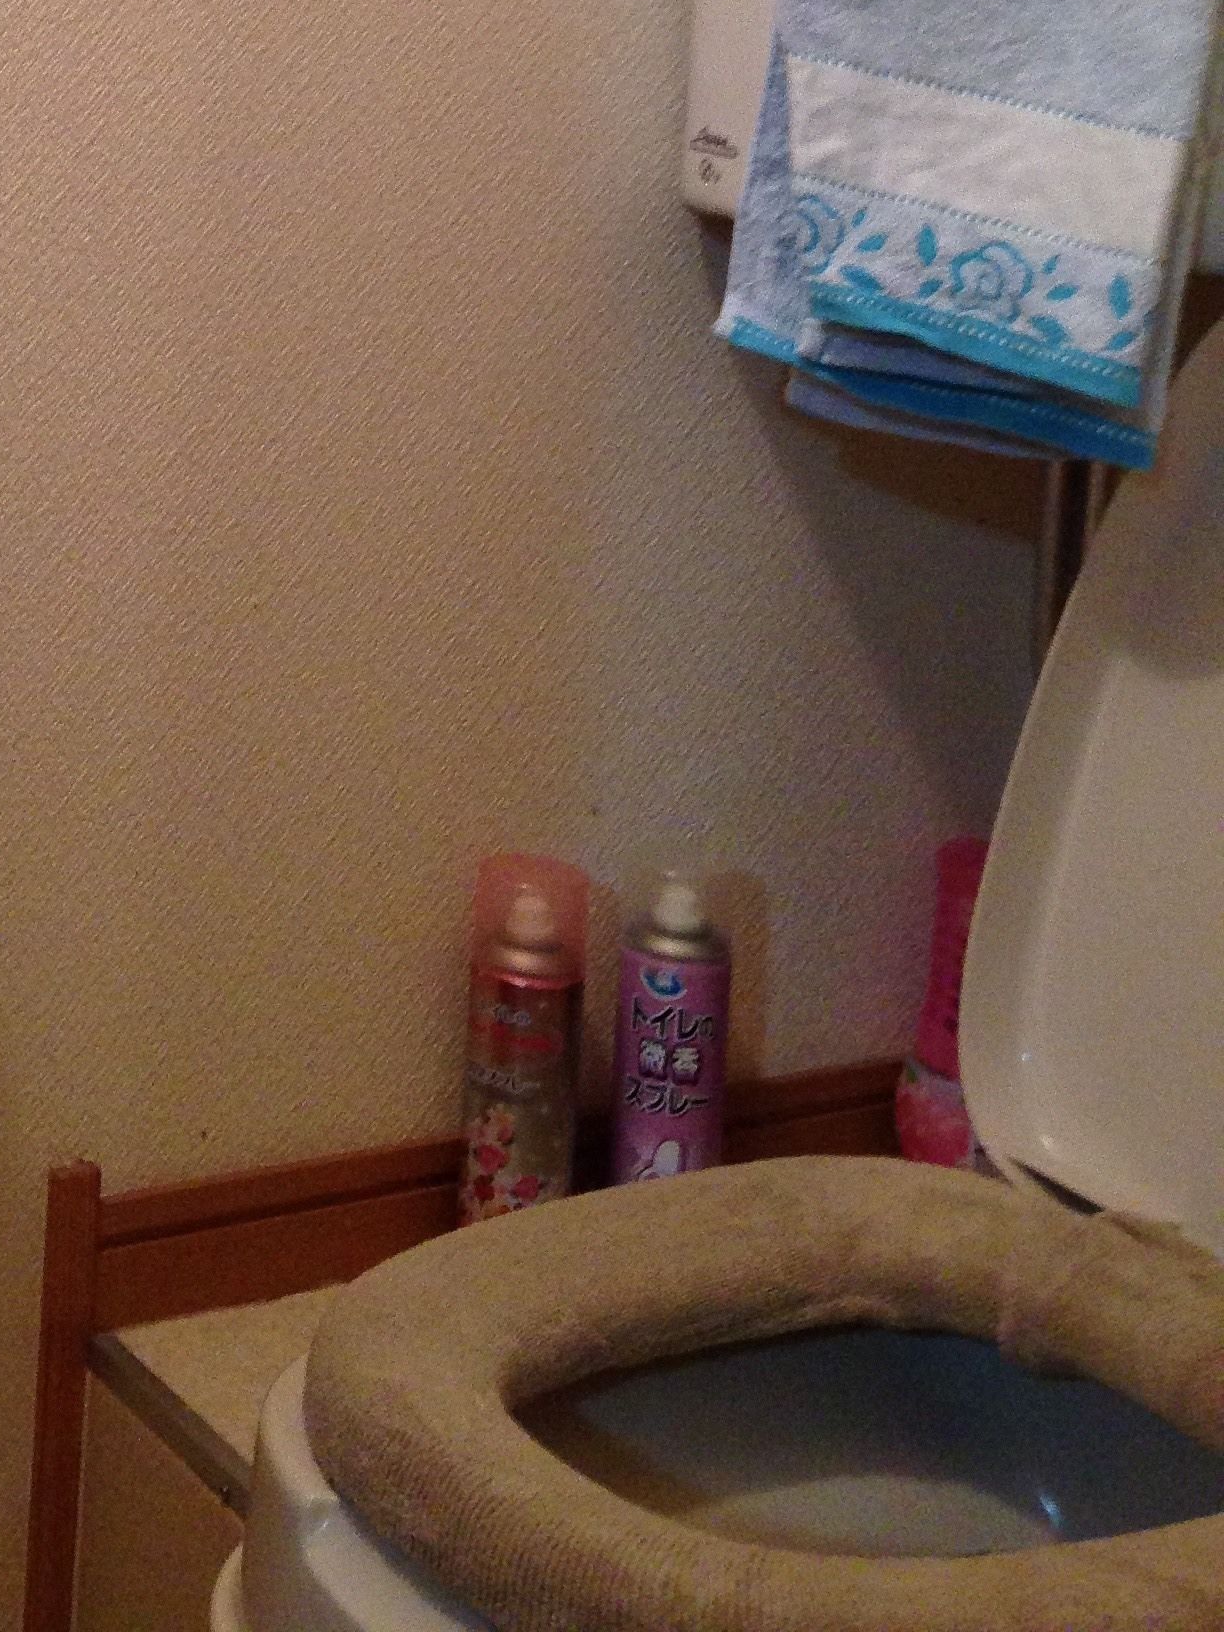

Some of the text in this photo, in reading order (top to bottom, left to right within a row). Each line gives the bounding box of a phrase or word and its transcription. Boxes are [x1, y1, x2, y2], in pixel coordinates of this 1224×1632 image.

[631, 994, 715, 1040] トイレの
[625, 1074, 712, 1116] スプレー
